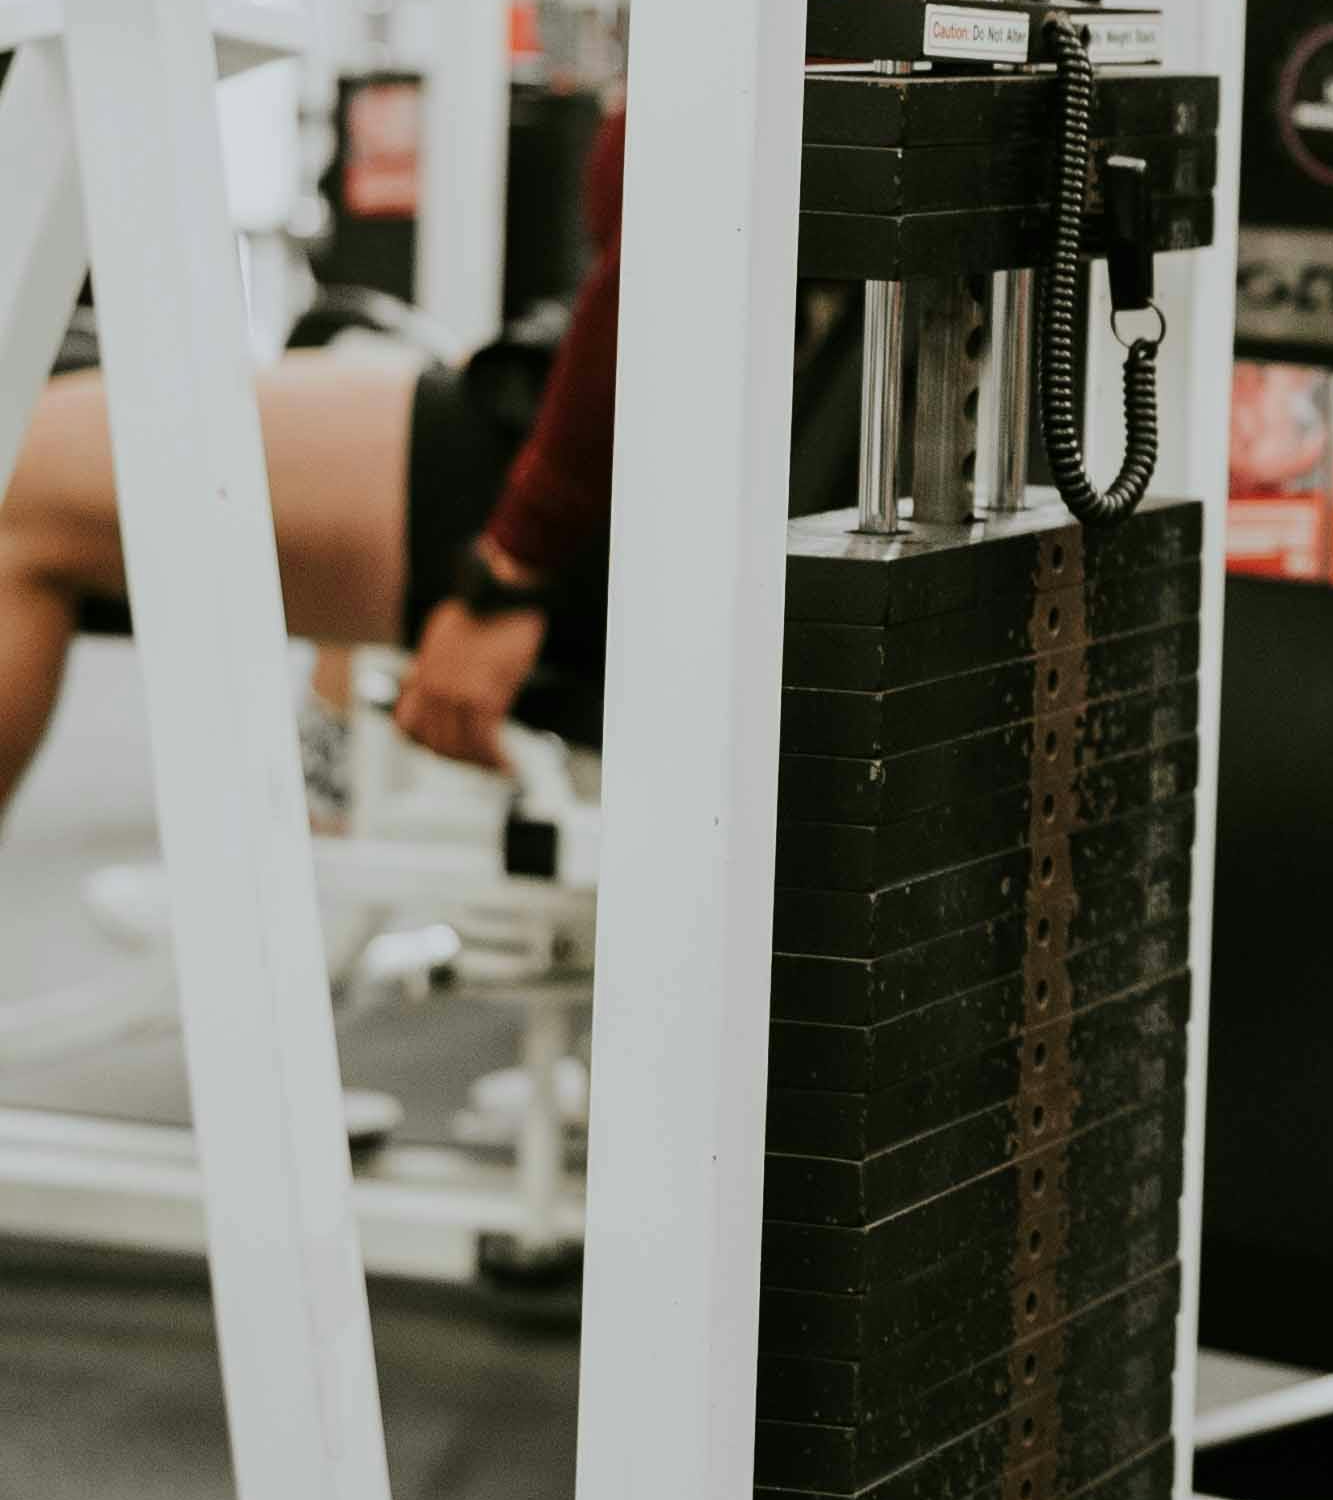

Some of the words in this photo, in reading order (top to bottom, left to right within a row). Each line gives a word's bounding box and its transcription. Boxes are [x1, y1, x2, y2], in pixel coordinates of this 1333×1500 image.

[973, 24, 985, 41] Do
[988, 26, 1003, 43] Not
[1007, 27, 1027, 43] Alter
